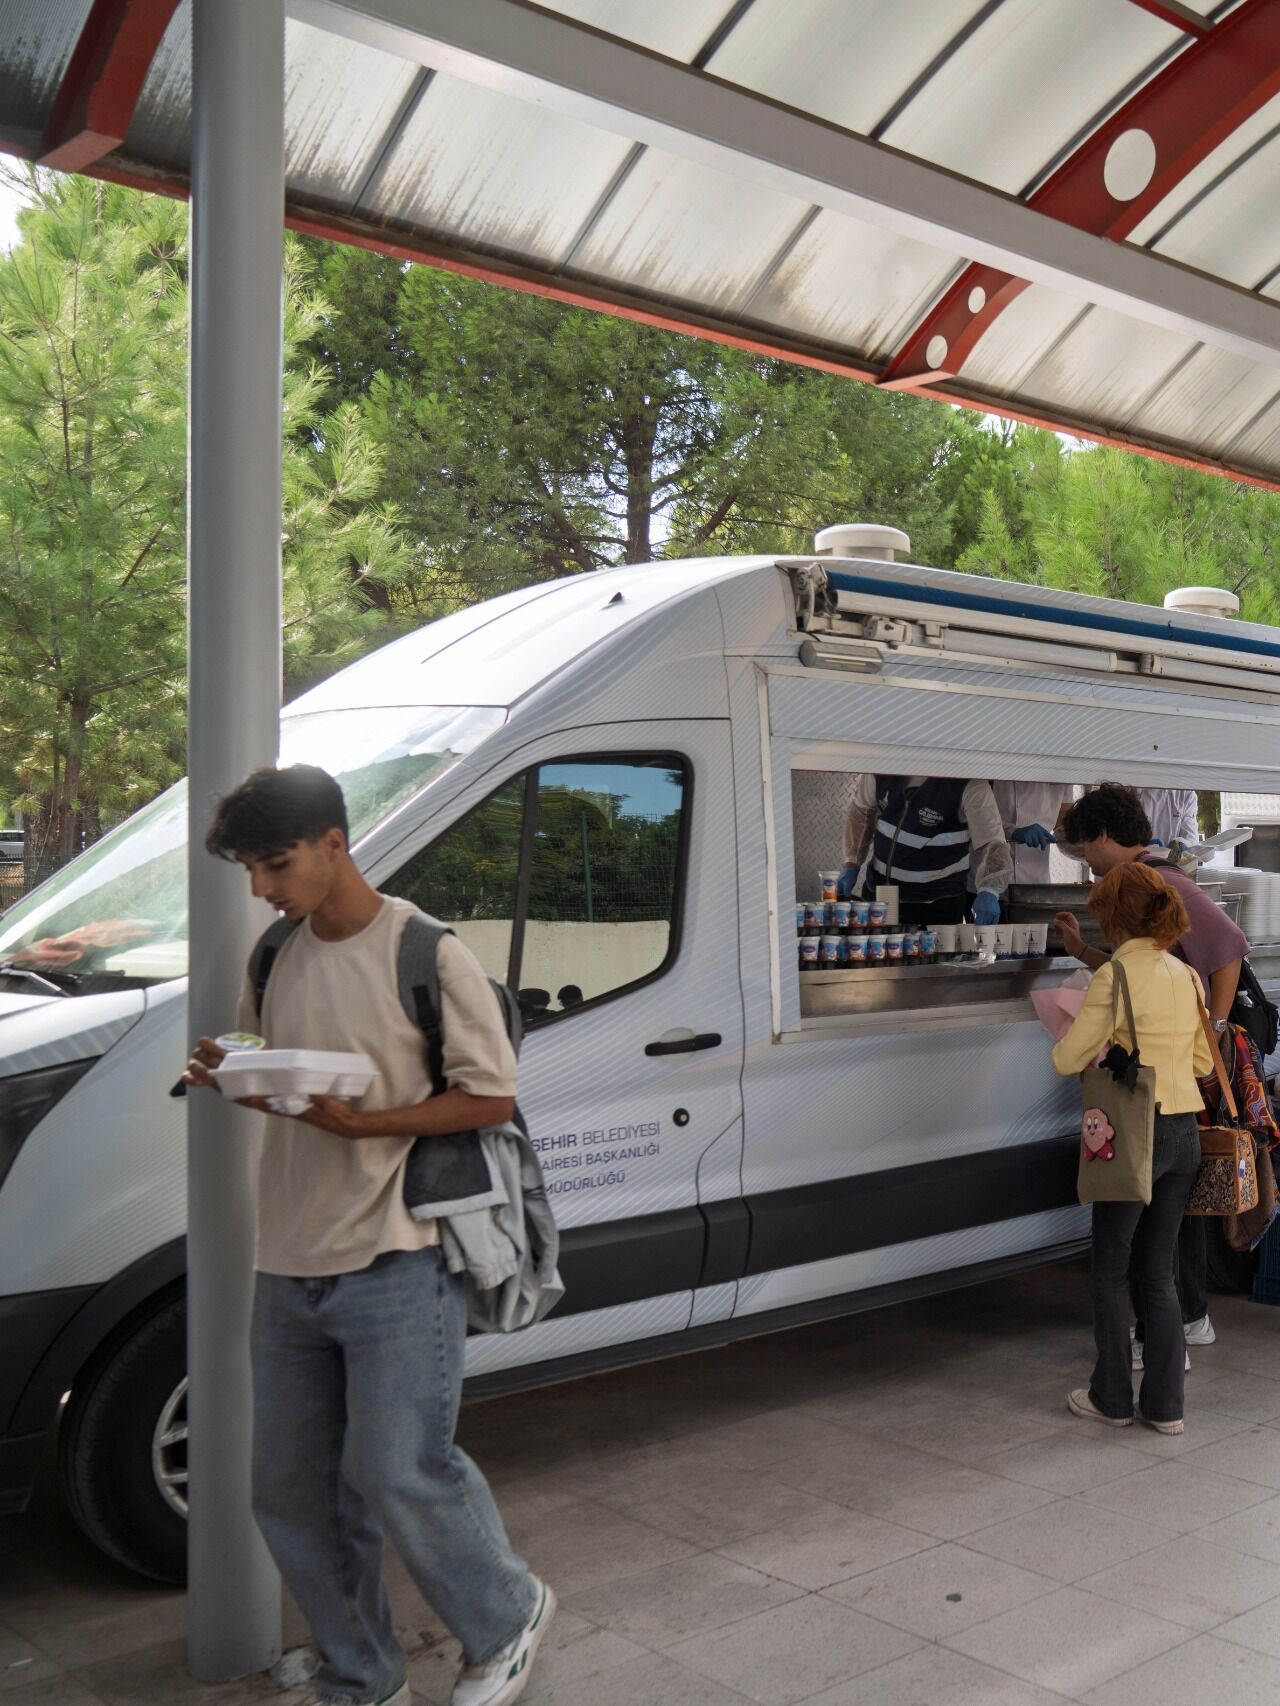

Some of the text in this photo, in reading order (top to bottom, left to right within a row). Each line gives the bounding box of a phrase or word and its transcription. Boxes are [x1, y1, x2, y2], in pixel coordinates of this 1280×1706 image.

[582, 1120, 660, 1146] BELEDİYESİ
[541, 1142, 660, 1171] AİRESİ BAŞKANLIĞI
